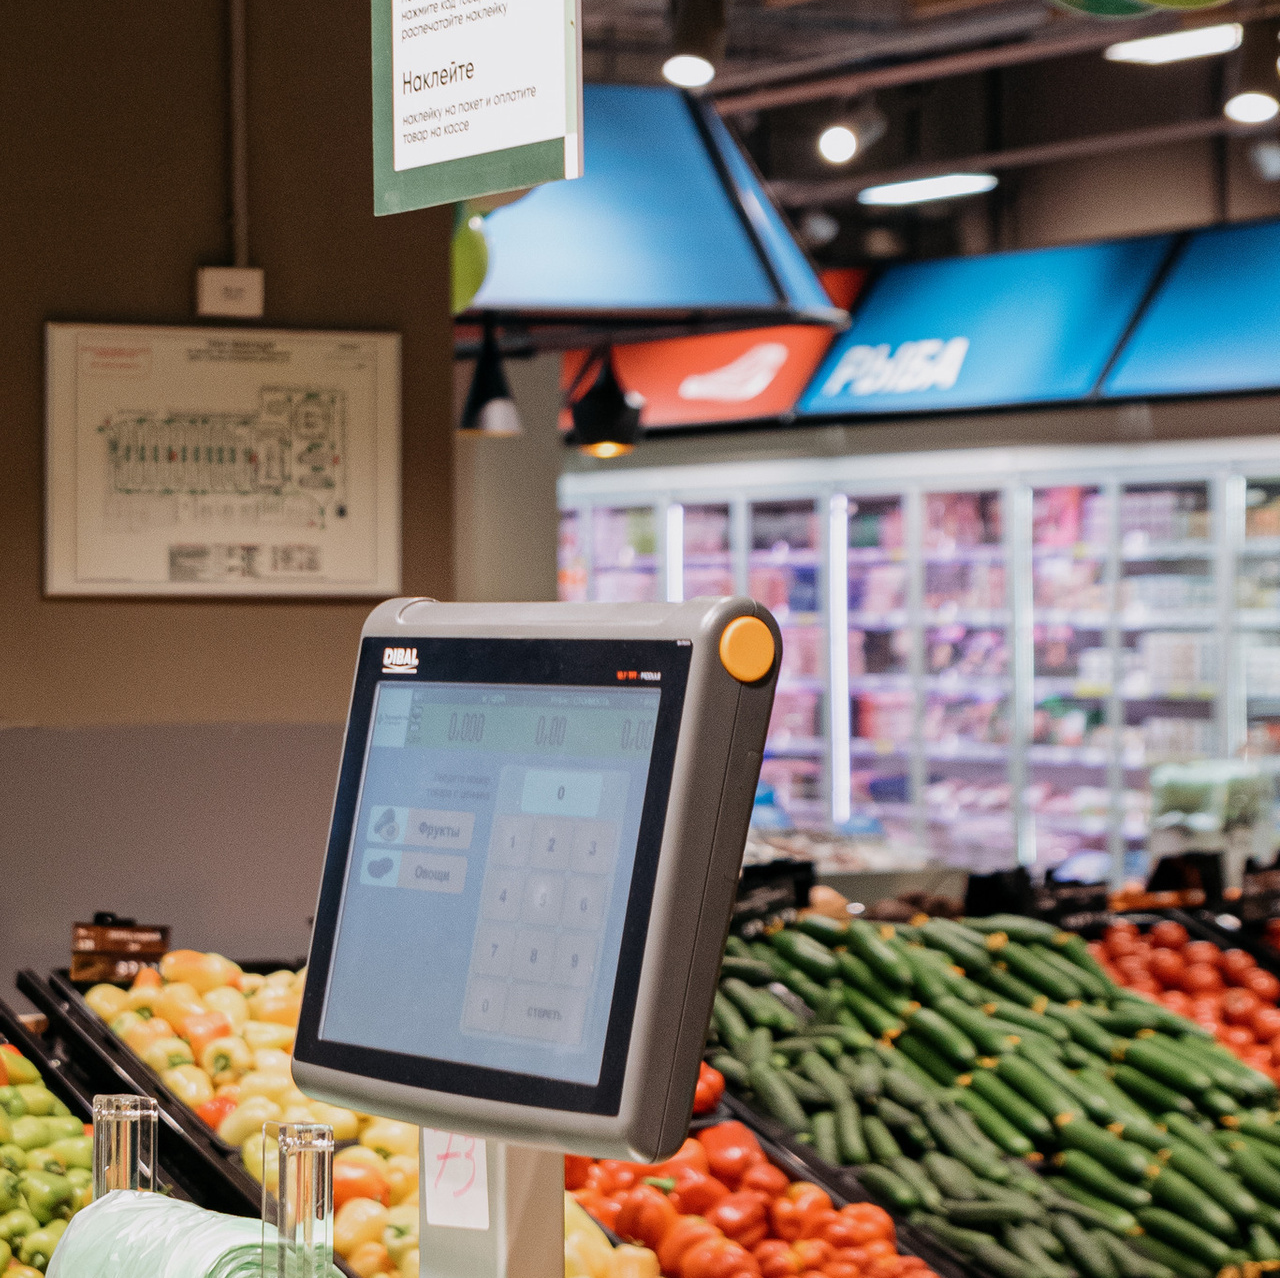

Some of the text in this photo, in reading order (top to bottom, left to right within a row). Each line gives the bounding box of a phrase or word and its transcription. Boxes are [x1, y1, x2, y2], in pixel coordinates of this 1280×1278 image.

[401, 2, 438, 22] нажмите
[401, 1, 509, 43] распечатайте наклейку
[402, 61, 474, 95] Наклейте
[402, 86, 536, 126] наклейку на пакет и оплатите
[403, 120, 470, 144] товар на кассе
[821, 336, 970, 397] РЫБА
[383, 646, 419, 666] DIBAL
[557, 784, 566, 801] 0
[418, 821, 460, 840] Фрукты
[510, 835, 598, 856] 1 2 3
[415, 865, 450, 882] Овощи
[499, 889, 507, 903] 4
[491, 943, 579, 969] 7 8 9
[481, 998, 489, 1013] 0
